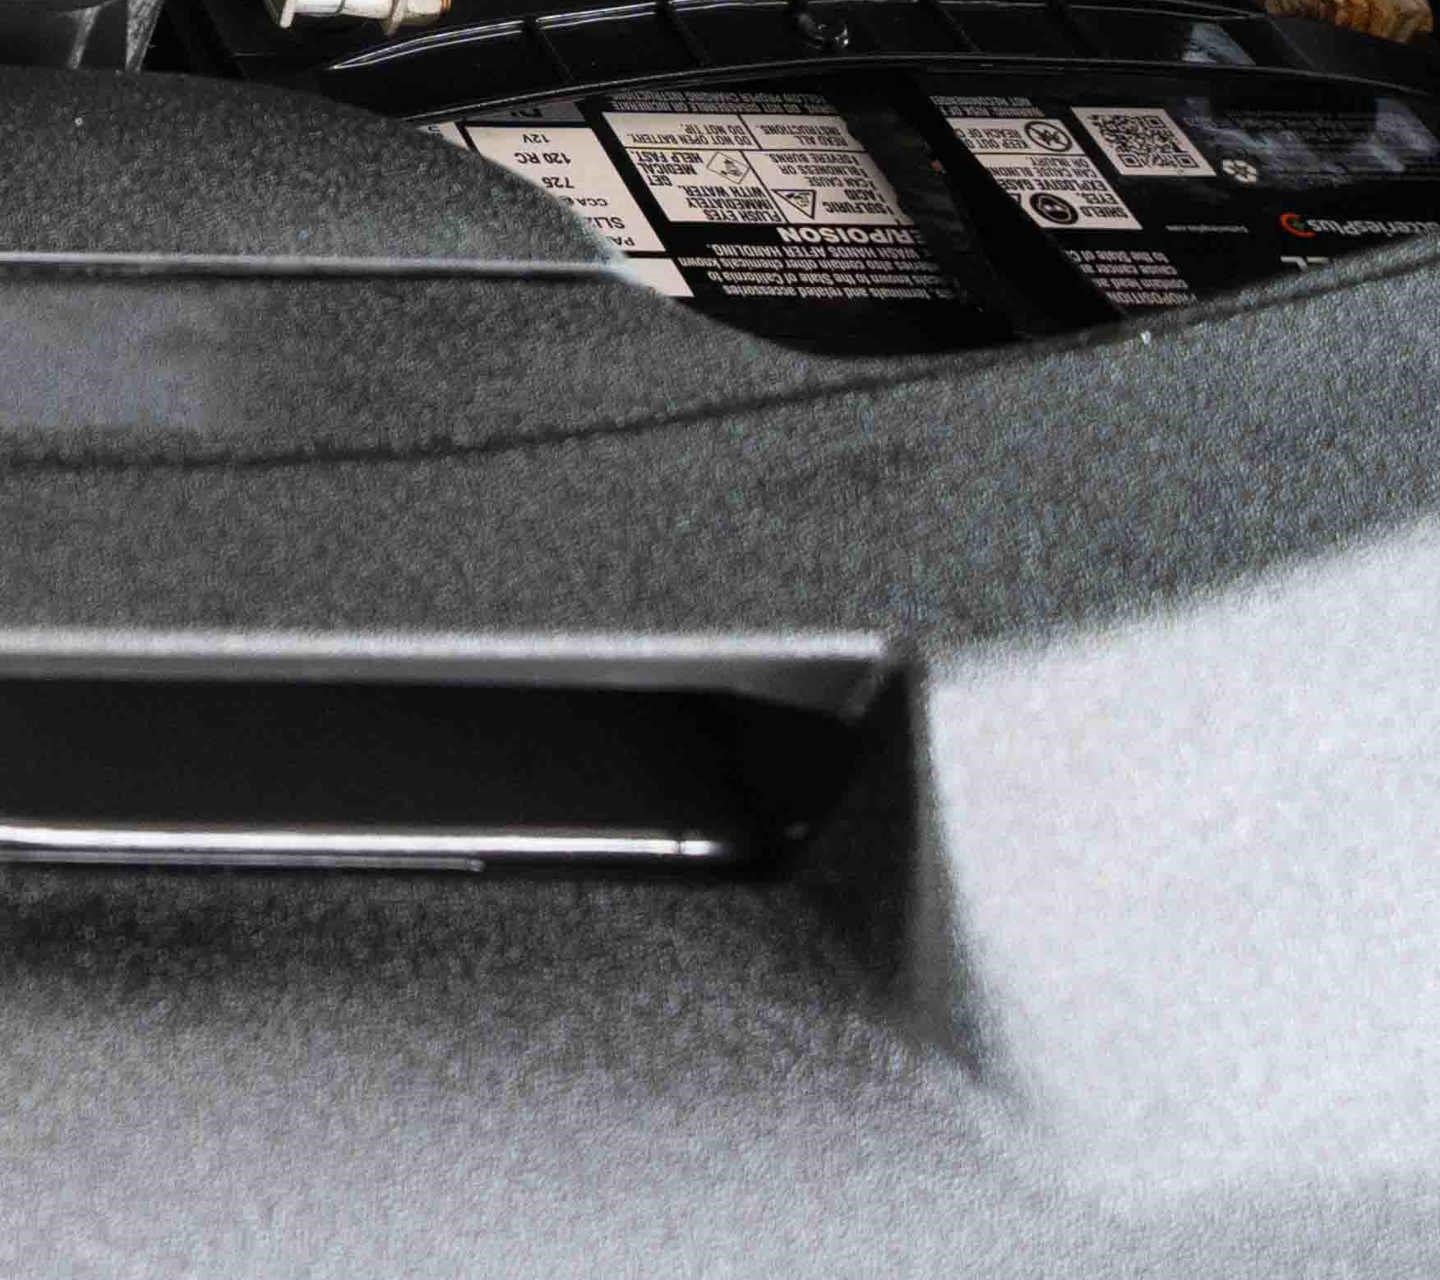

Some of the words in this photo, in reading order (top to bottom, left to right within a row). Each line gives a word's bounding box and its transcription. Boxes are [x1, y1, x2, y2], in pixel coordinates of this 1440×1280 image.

[704, 125, 727, 135] NOT
[728, 125, 745, 135] DO
[521, 134, 549, 143] 12V
[679, 134, 709, 145] OPEN
[712, 135, 733, 145] NOT
[734, 135, 752, 145] DO
[514, 152, 539, 164] RC
[543, 152, 571, 164] 120
[630, 151, 668, 162] FAST.
[669, 151, 703, 163] HELP
[637, 162, 697, 175] MEDICAL
[1033, 167, 1072, 178] CAUSE
[1073, 167, 1098, 178] CAN
[541, 177, 574, 189] 725
[646, 175, 672, 186] GET
[1033, 179, 1108, 191] EXPLOSIVE
[678, 185, 728, 198] WATER.
[729, 186, 766, 198] WITH
[576, 198, 608, 207] CCA
[685, 197, 773, 210] IMMEDIATELY
[703, 209, 737, 221] EYES
[738, 211, 782, 222] FLUSH
[1080, 206, 1128, 218] SHIELD
[781, 245, 828, 258] AFTER
[677, 256, 721, 269] known
[720, 258, 783, 271] chemicals
[707, 271, 722, 283] to
[721, 272, 784, 284] California
[722, 285, 797, 297] accessories
